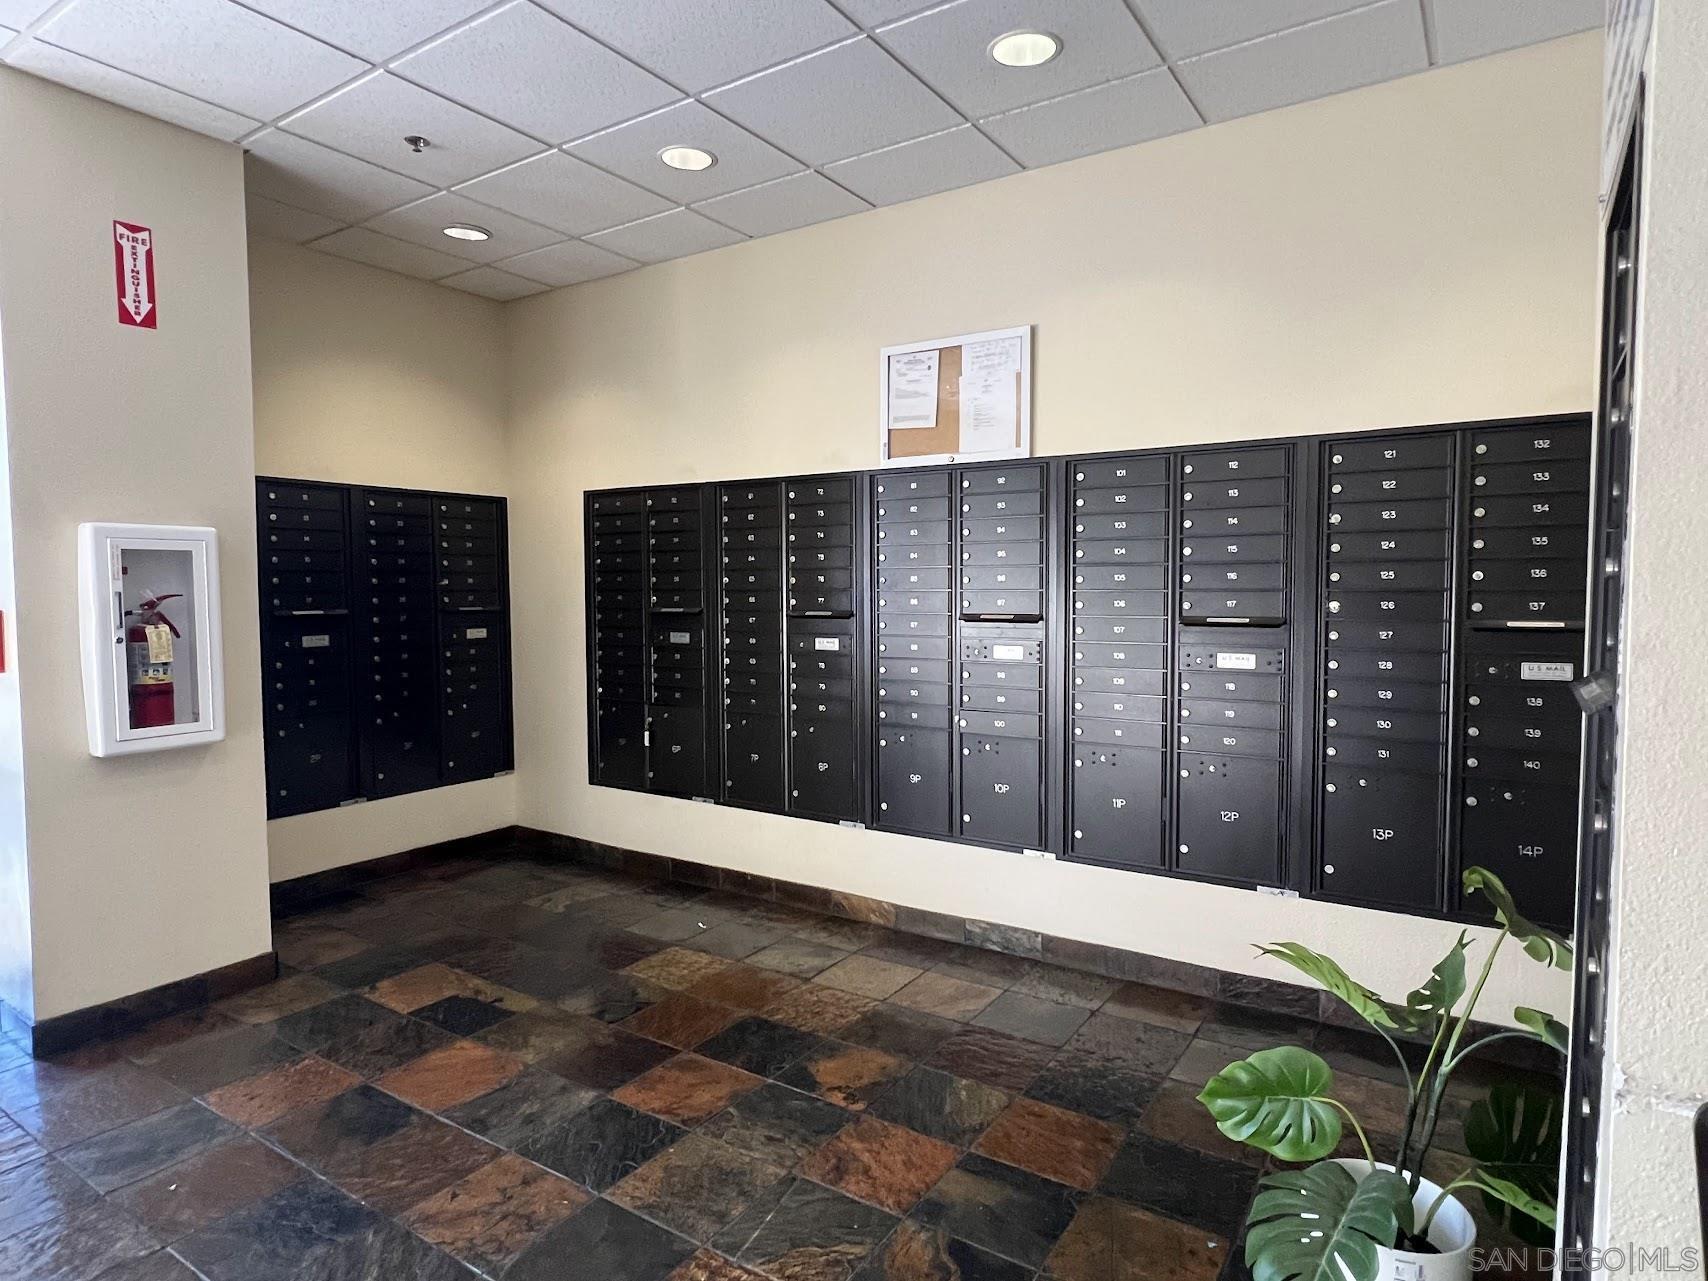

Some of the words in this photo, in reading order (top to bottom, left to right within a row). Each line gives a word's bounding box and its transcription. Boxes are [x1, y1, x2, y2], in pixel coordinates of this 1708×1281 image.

[119, 233, 147, 246] FIRE
[1534, 440, 1550, 448] 132
[1384, 450, 1396, 458] 121
[1533, 472, 1549, 481] 133
[1382, 481, 1396, 489] 122
[1533, 504, 1549, 512] 134
[1382, 511, 1396, 519] 123
[1381, 541, 1395, 549] 124
[1532, 537, 1548, 545] 135
[1380, 571, 1395, 579] 125
[1531, 569, 1547, 577] 136
[1380, 601, 1395, 609] 126
[1529, 602, 1545, 610] 137
[1379, 631, 1393, 639] 127
[1378, 661, 1392, 669] 128
[1378, 691, 1392, 699] 129
[1527, 698, 1543, 706] 138
[1525, 729, 1541, 737] 139
[1378, 750, 1389, 758] 131
[1524, 761, 1540, 769] 140
[910, 774, 921, 783] 9P
[994, 784, 1009, 793] 10P
[1113, 799, 1126, 808] 11P
[1221, 811, 1239, 821] 12P
[1373, 829, 1393, 840] 13P
[1518, 845, 1543, 857] 14P
